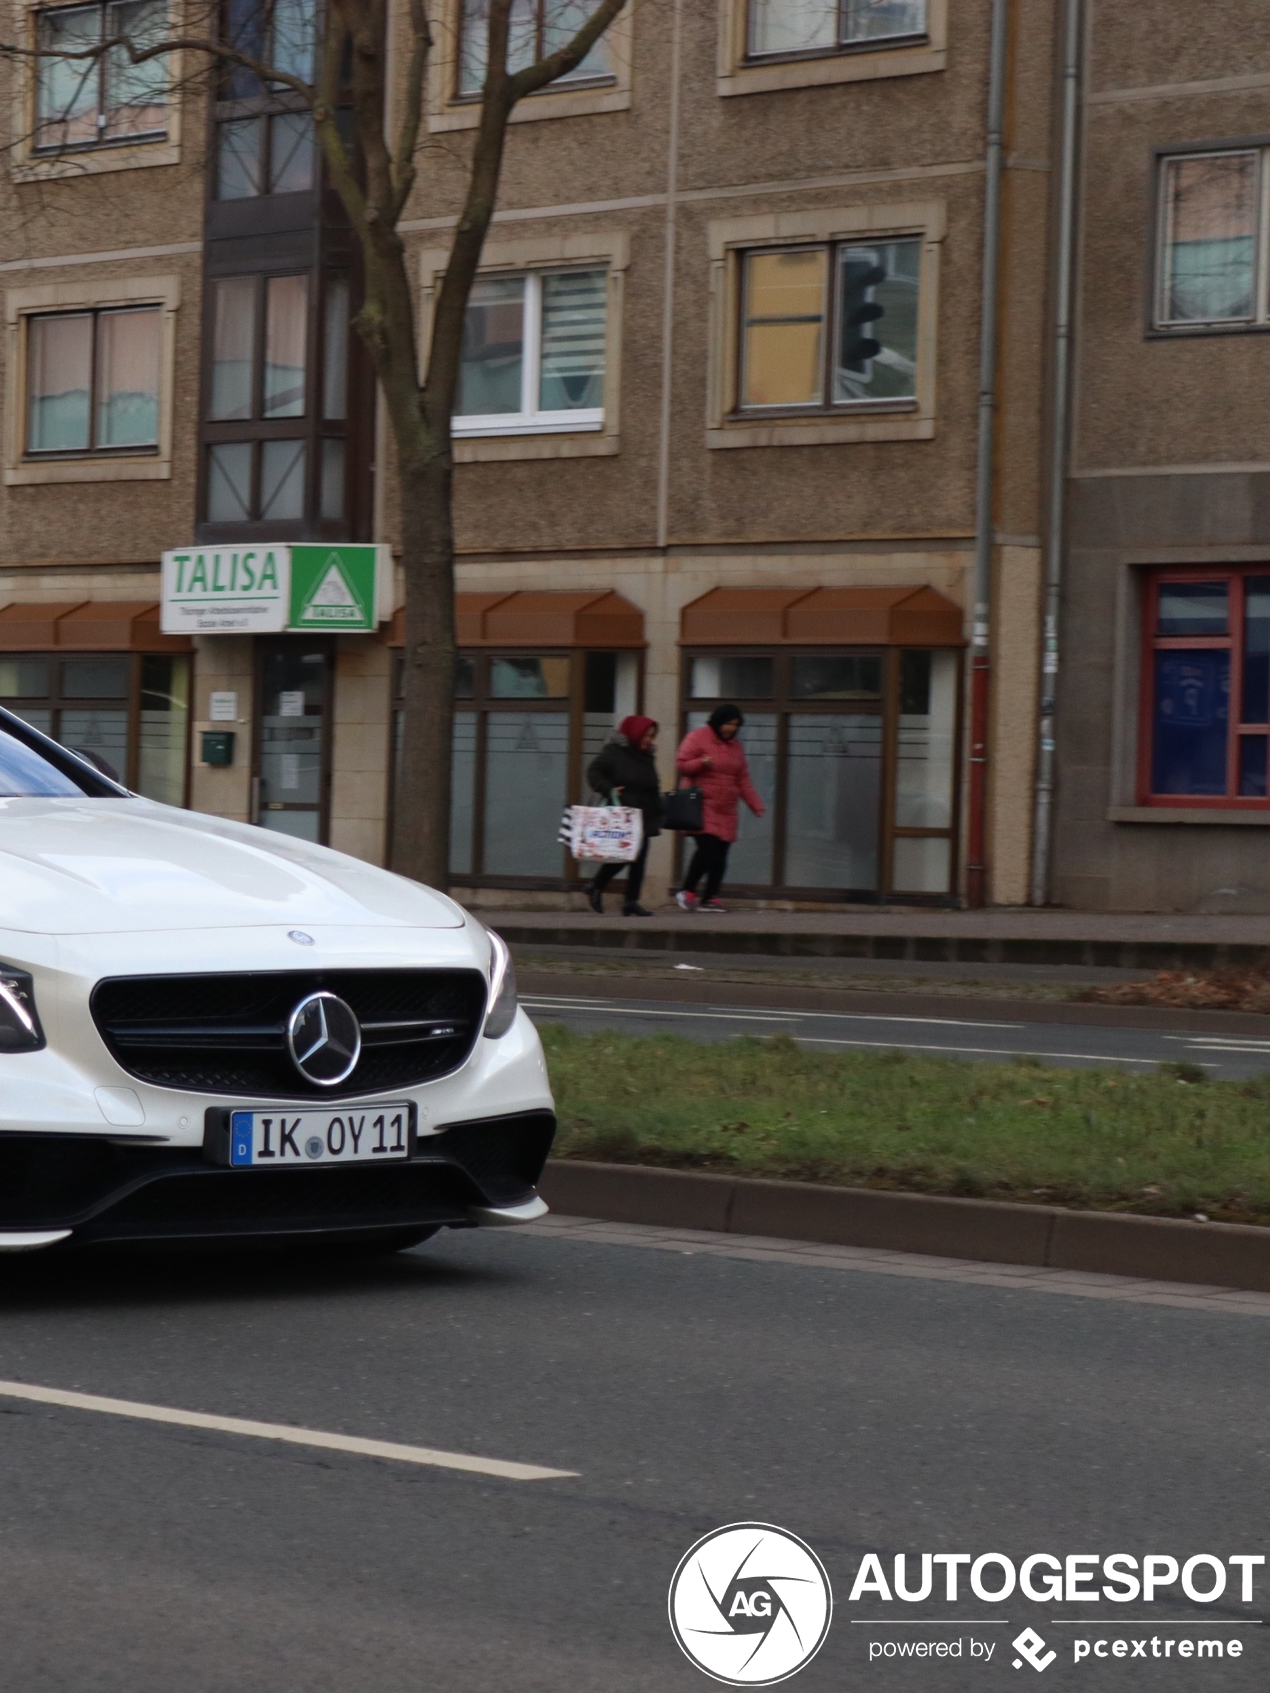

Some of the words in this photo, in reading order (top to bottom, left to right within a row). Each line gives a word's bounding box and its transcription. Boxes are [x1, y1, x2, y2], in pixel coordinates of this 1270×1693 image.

[173, 552, 278, 593] TALISA
[238, 1144, 247, 1156] D
[258, 1118, 302, 1158] IK
